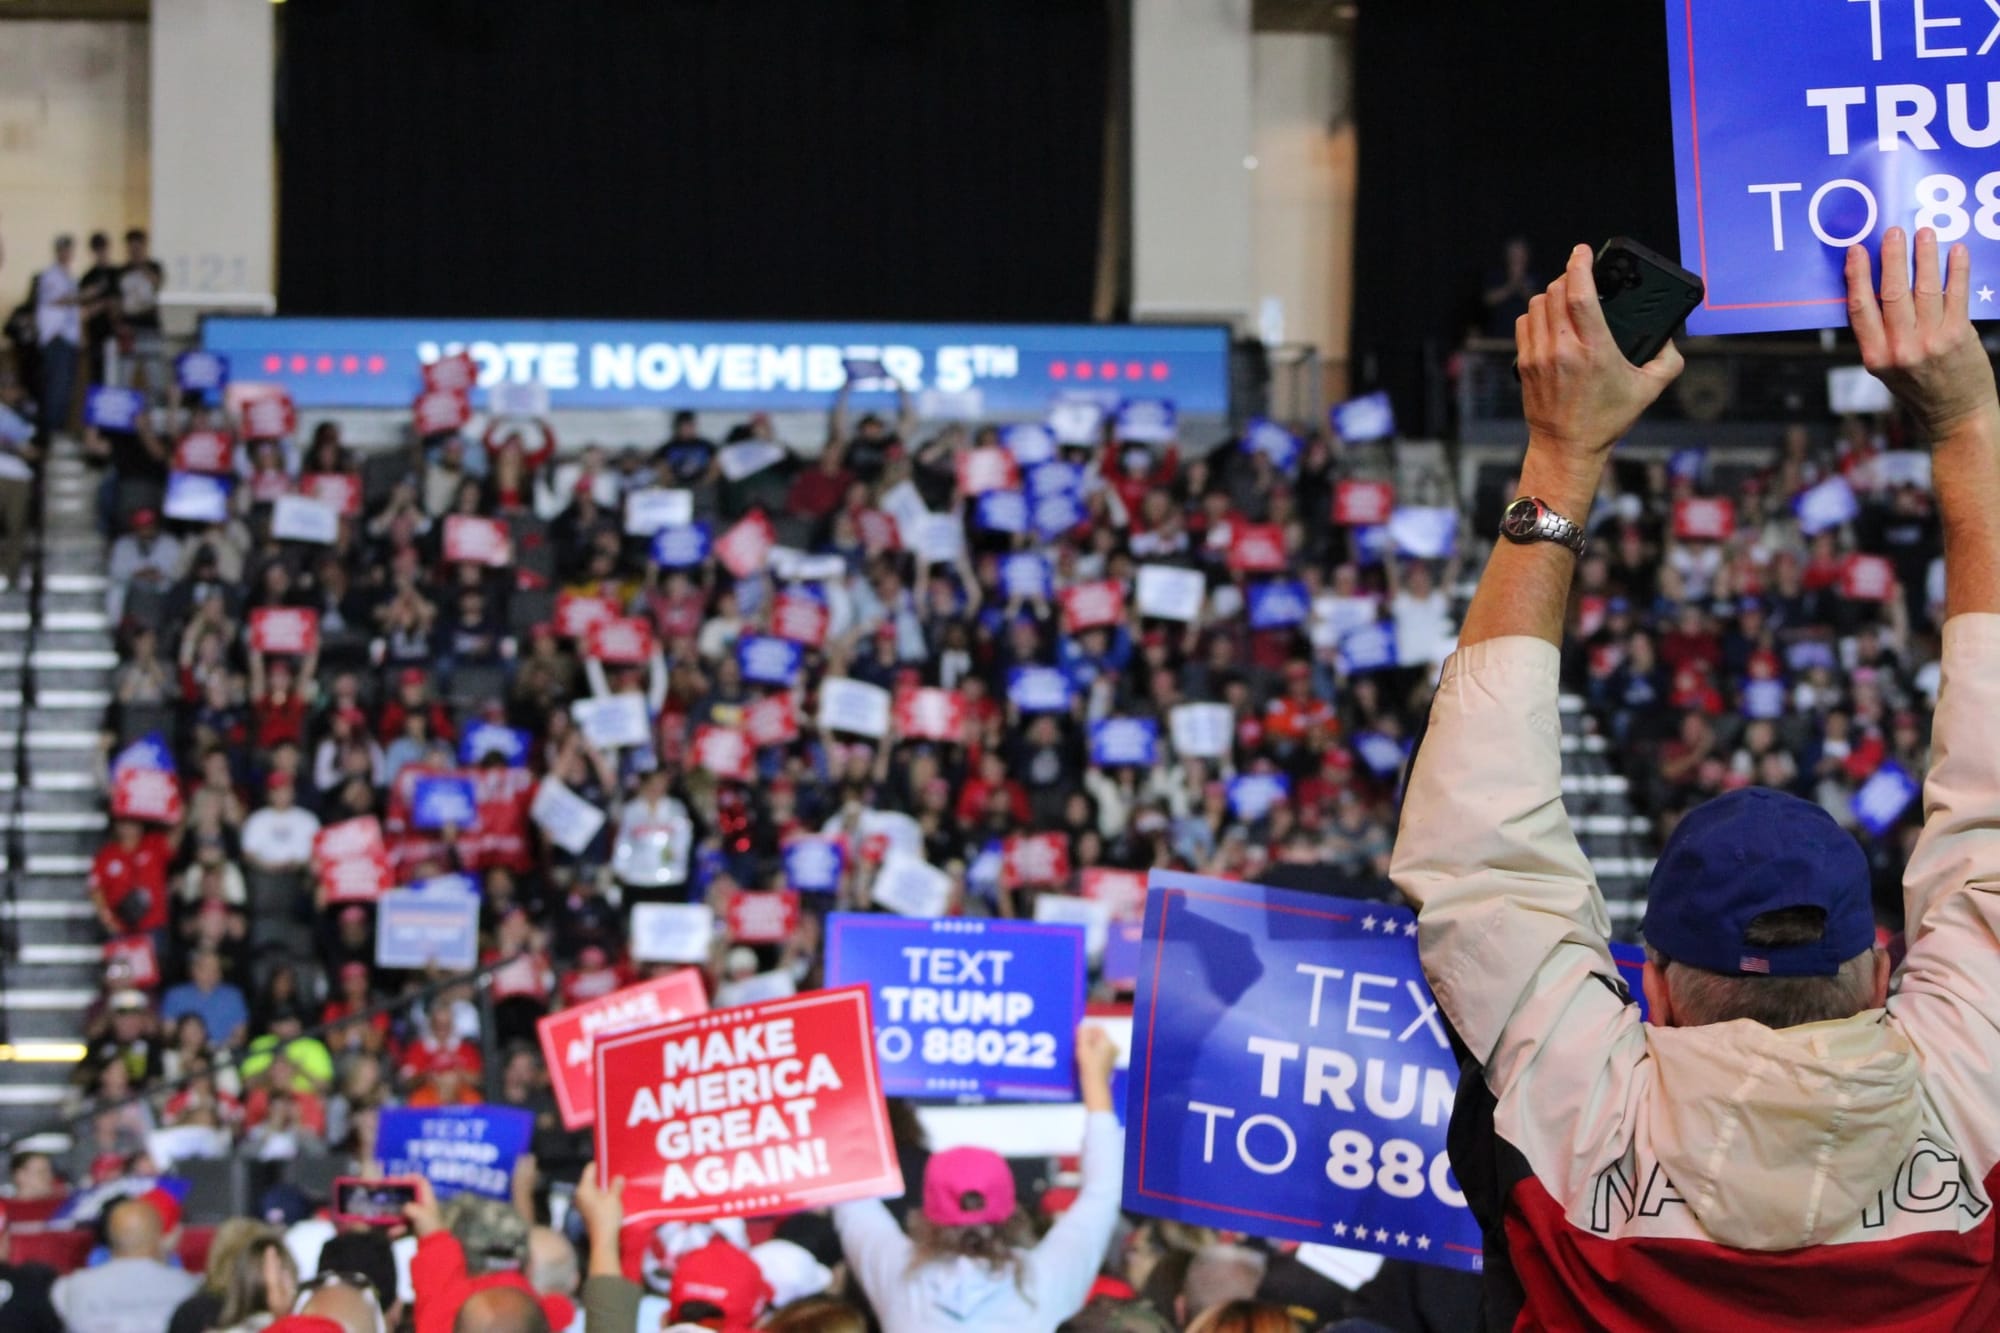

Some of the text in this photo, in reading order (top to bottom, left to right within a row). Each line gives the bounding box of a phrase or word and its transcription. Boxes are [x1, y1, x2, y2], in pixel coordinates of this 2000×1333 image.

[1748, 179, 1878, 251] TO
[590, 343, 924, 392] NOVEMBER
[902, 947, 1014, 986] TEXT
[880, 986, 1034, 1027] TRUMP
[662, 1018, 796, 1079] MAKE
[873, 1026, 1057, 1069] O 88022
[627, 1053, 843, 1127] AMERICA
[656, 1097, 817, 1160] GREAT
[1188, 1101, 1297, 1175] TO
[661, 1138, 831, 1202] AGAIN!
